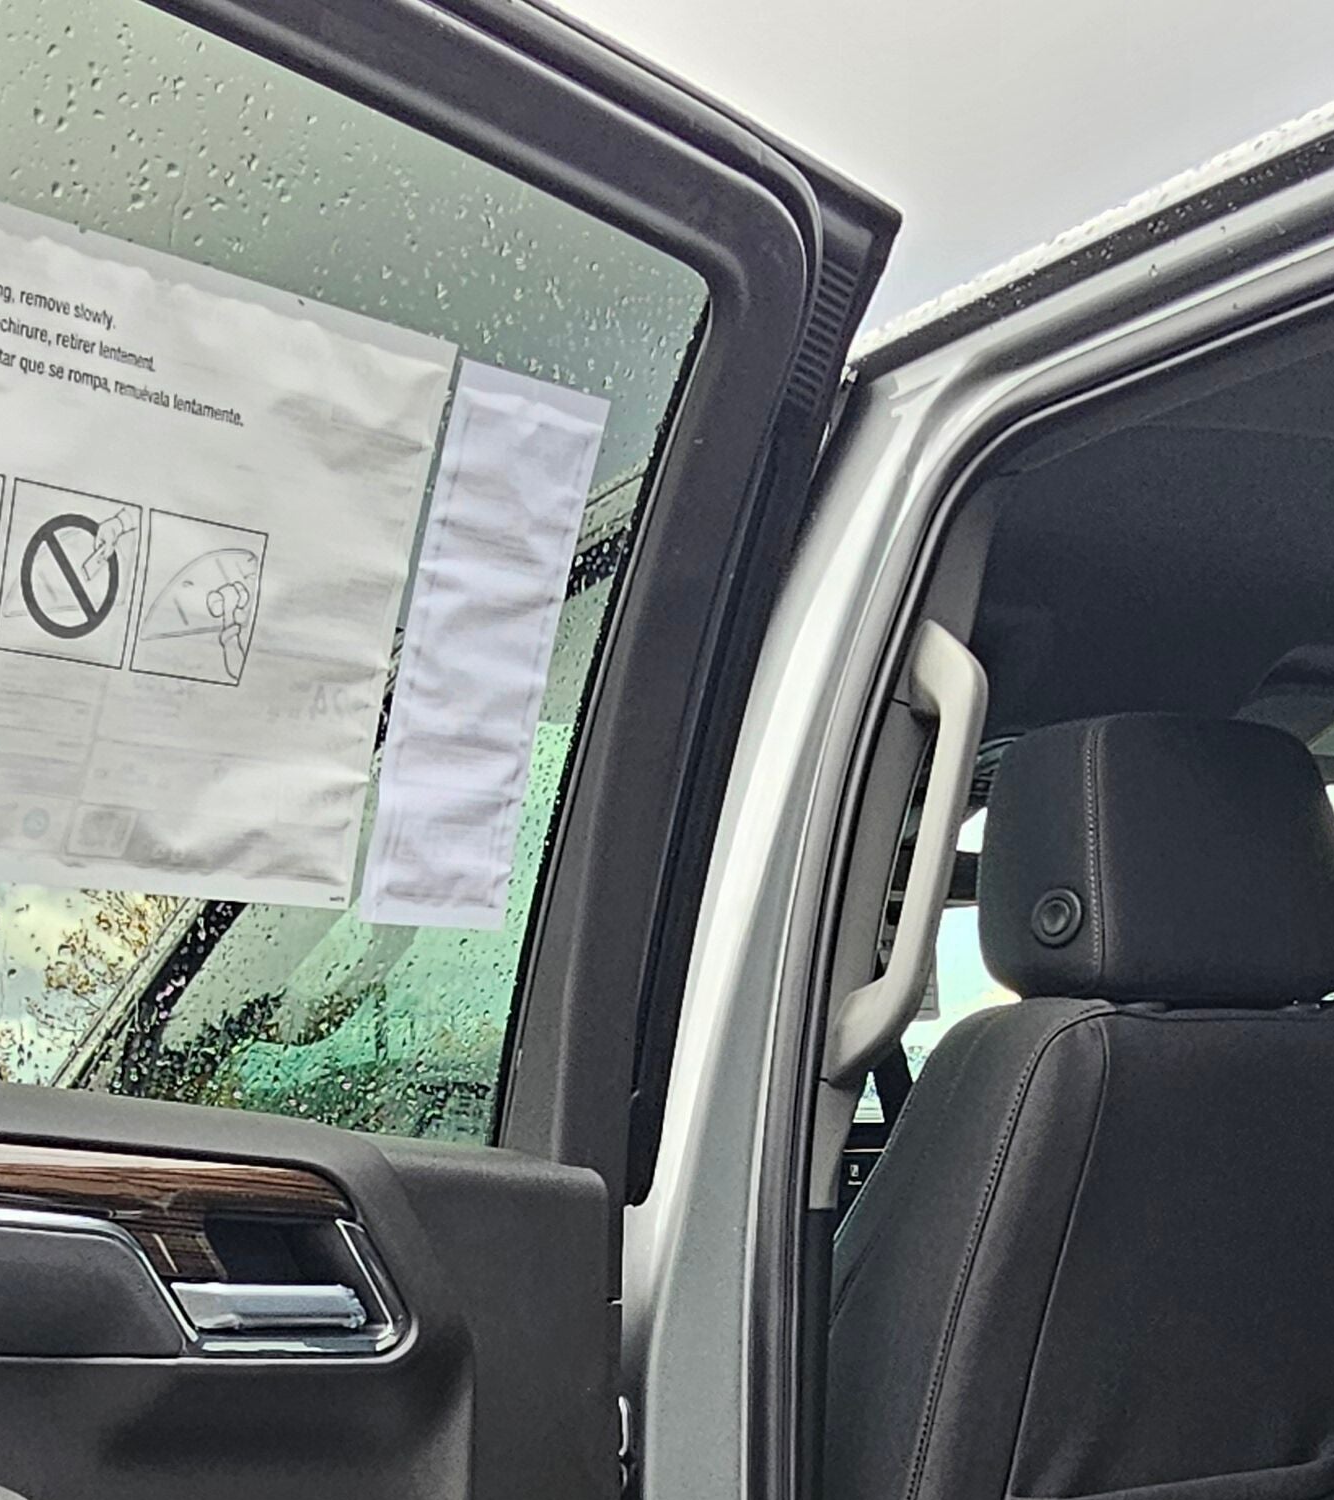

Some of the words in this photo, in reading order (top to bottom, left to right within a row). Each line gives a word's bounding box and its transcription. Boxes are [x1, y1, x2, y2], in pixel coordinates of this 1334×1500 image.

[19, 290, 70, 315] remove
[74, 303, 116, 331] slowly.
[55, 332, 96, 354] retirer
[19, 355, 45, 375] que
[48, 363, 65, 380] se
[67, 367, 111, 393] rompa,
[173, 394, 244, 427] lentamente.
